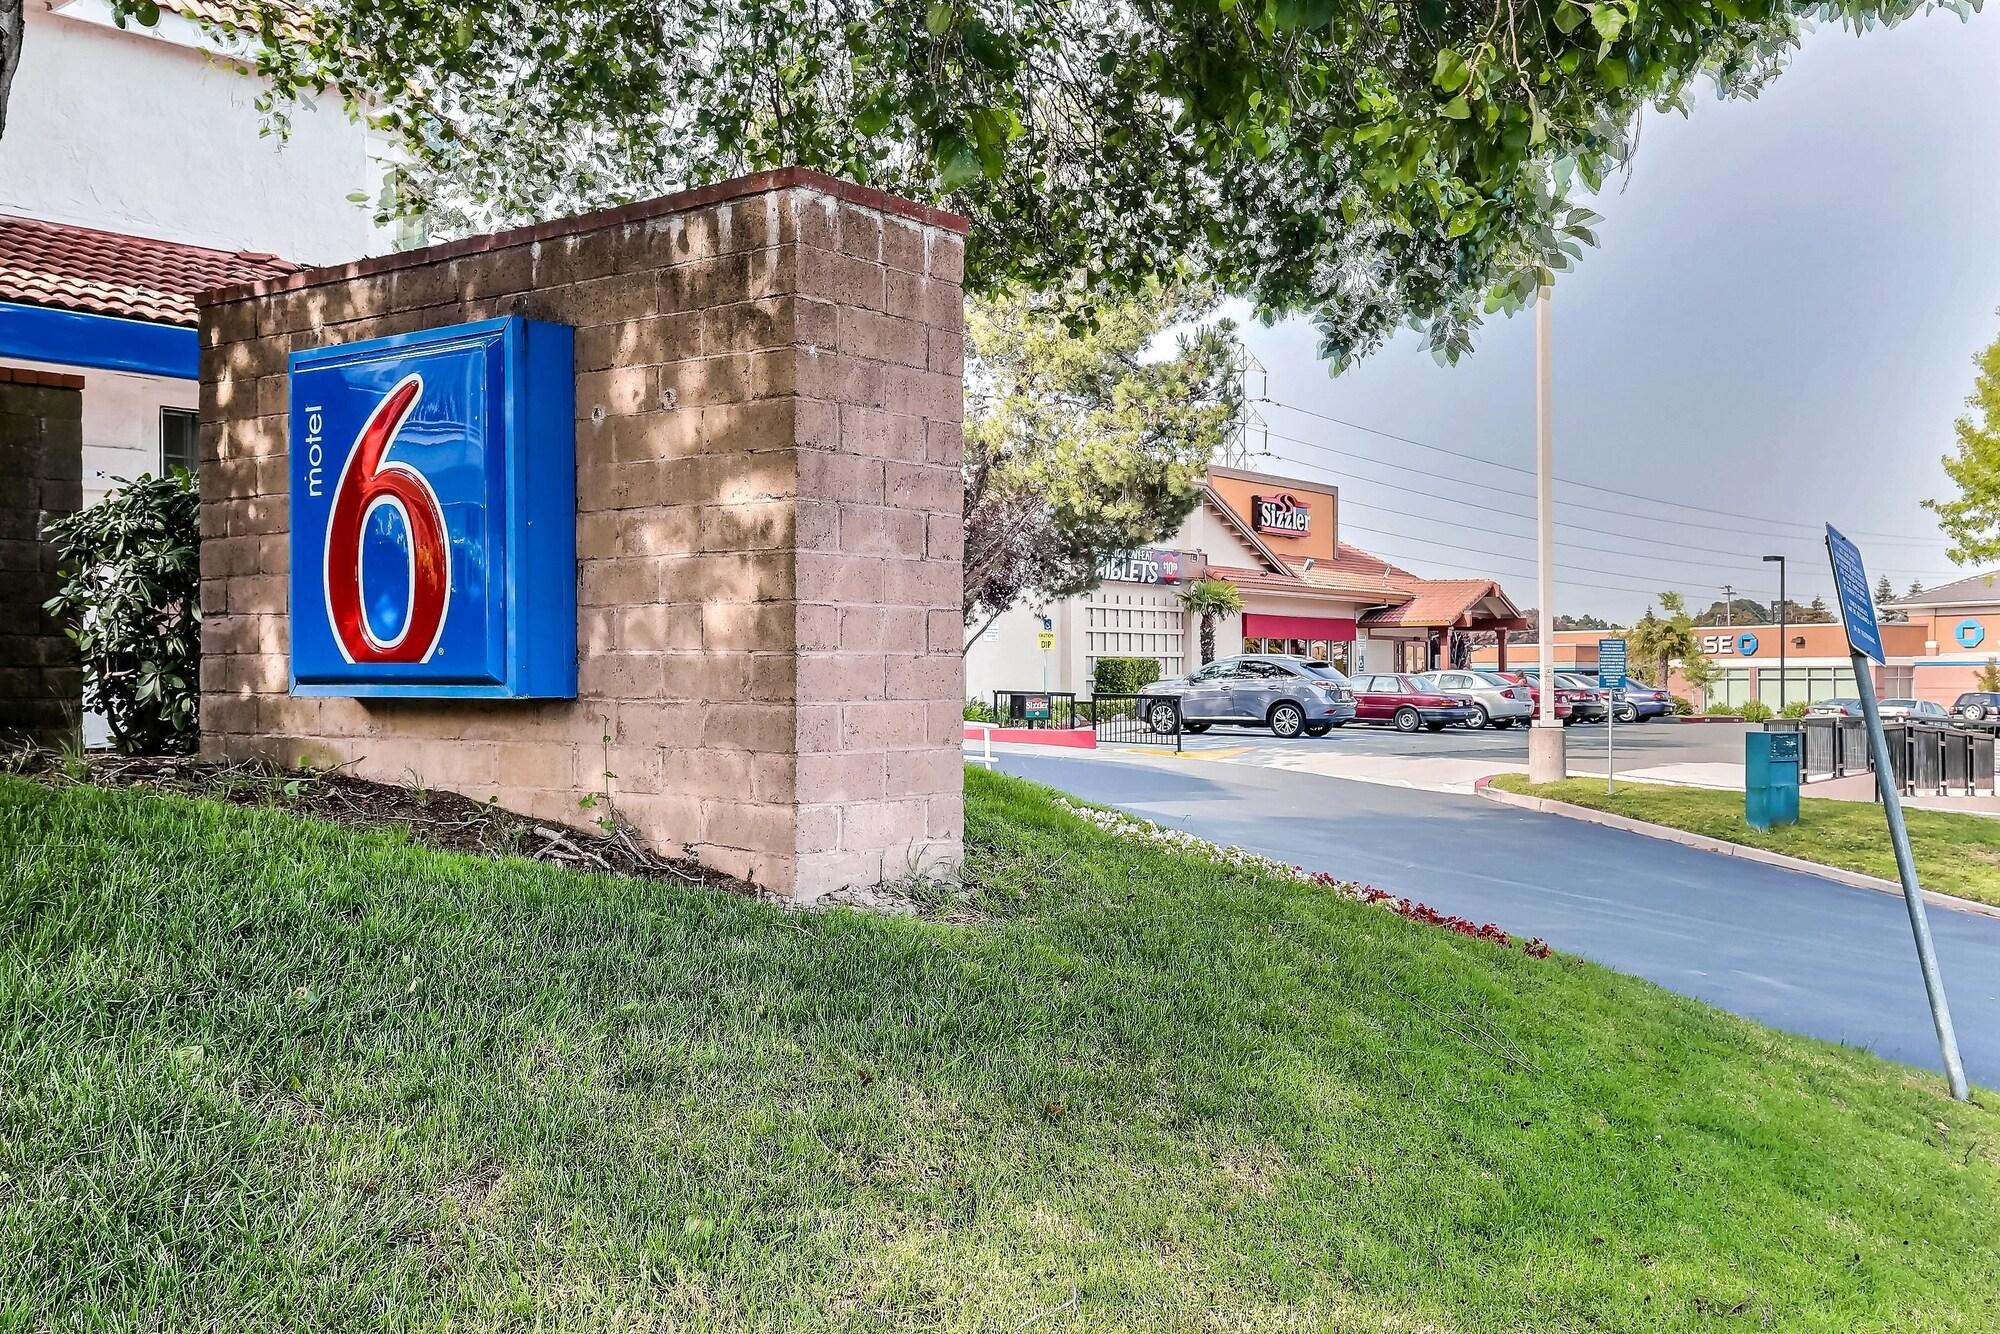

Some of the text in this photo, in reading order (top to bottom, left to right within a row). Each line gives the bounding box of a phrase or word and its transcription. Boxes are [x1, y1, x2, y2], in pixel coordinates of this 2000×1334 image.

[305, 405, 322, 497] motel
[323, 372, 452, 664] 6
[1261, 500, 1311, 531] Sizzler
[1041, 640, 1052, 648] DIP
[1025, 701, 1048, 709] Sizzler
